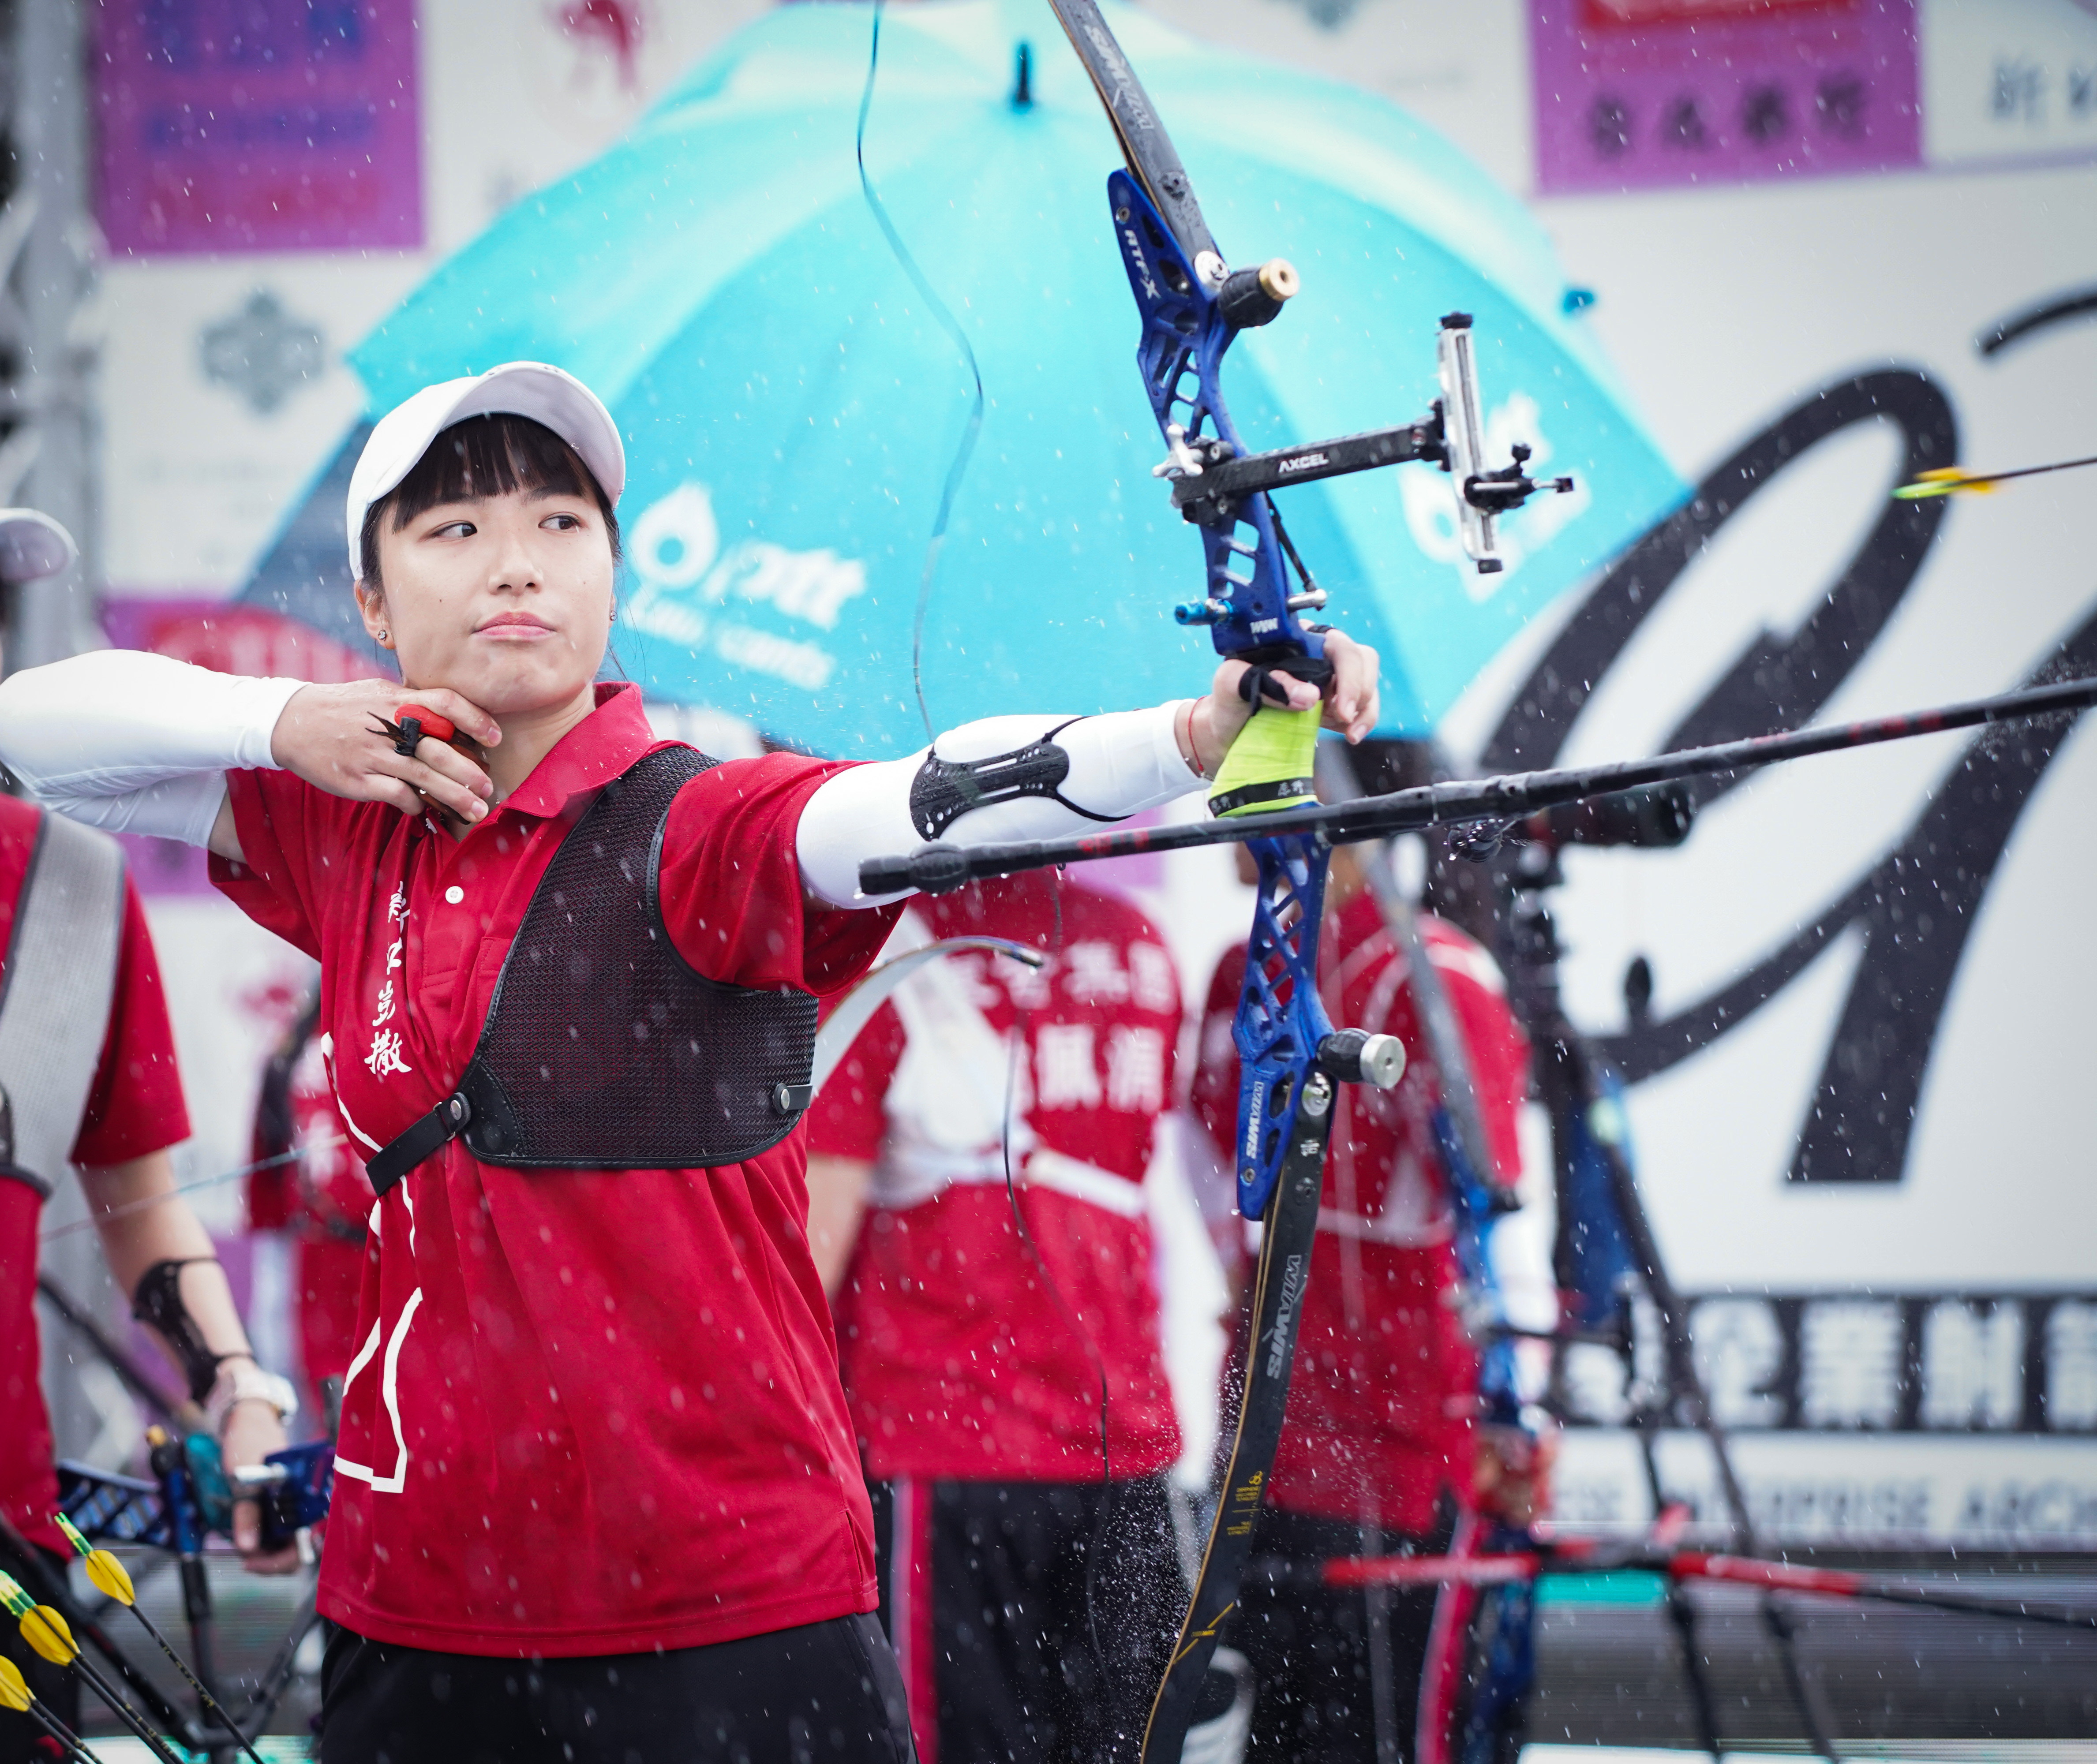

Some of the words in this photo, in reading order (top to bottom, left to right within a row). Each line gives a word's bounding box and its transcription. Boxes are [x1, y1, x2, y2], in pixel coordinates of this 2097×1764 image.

[1278, 452, 1329, 474] AXCEL
[1245, 1080, 1264, 1160] WIAWIS
[1266, 1253, 1303, 1380] WIAWIS
